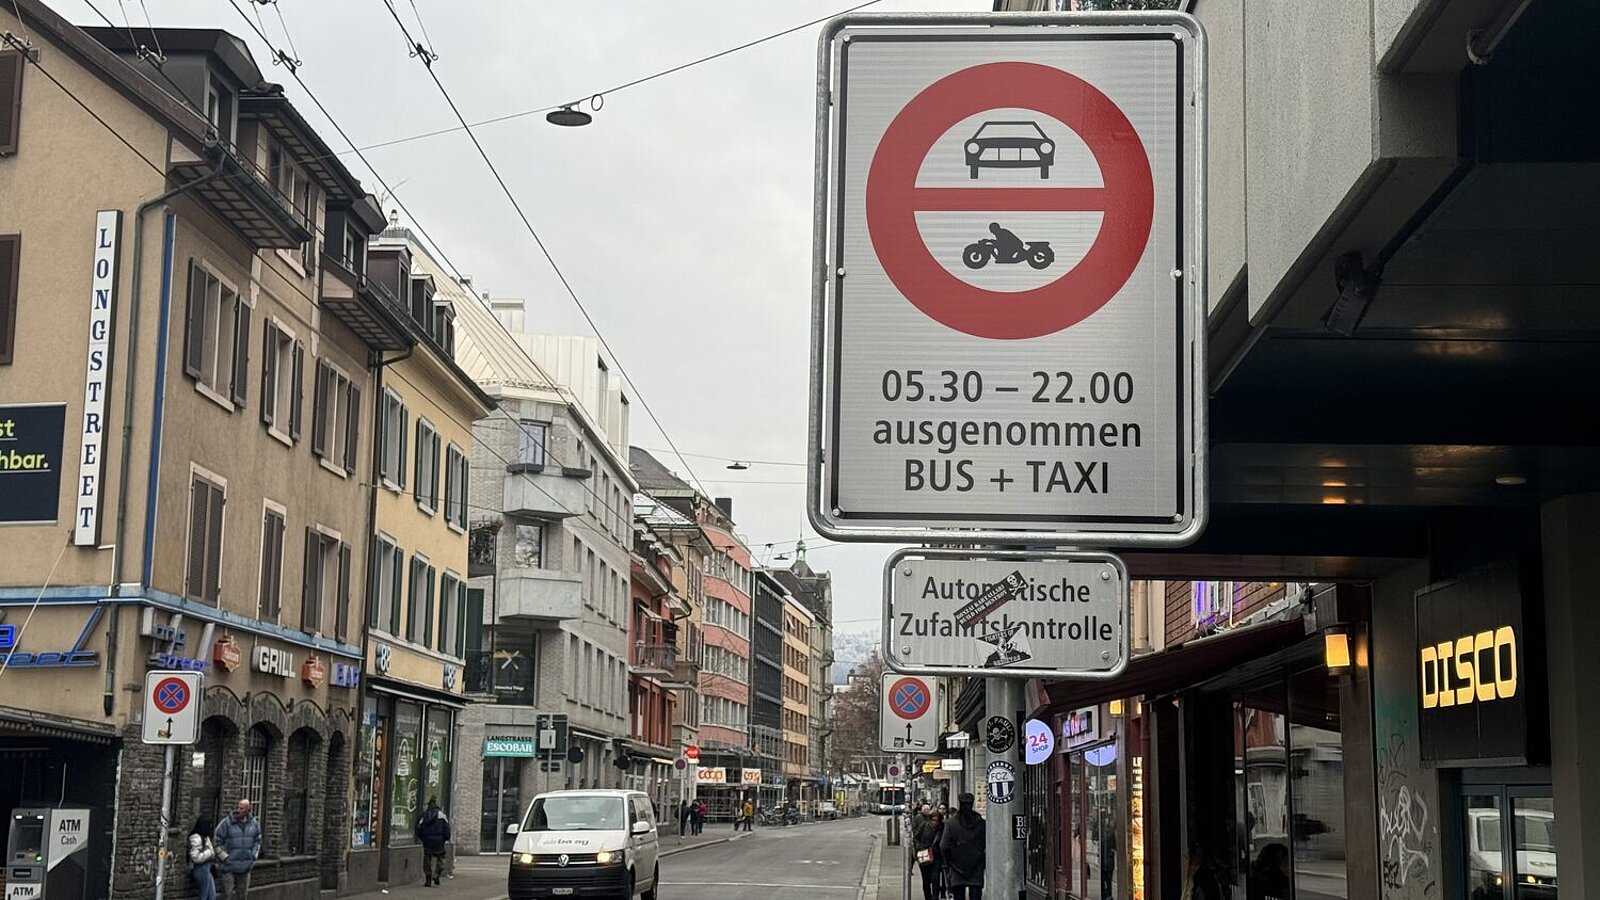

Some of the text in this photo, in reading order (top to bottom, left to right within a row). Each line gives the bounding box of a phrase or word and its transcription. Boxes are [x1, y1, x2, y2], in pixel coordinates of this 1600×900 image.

[81, 228, 112, 528] LONGSTREET
[882, 370, 983, 402] 05.30
[1032, 371, 1134, 404] 22.00
[873, 420, 1141, 454] ausgenommen
[905, 459, 975, 492] BUS
[1026, 461, 1108, 494] TAXI
[922, 576, 1090, 602] Autotische
[259, 646, 296, 678] GRILL
[335, 662, 360, 688] BAR
[1421, 626, 1517, 709] DISCO
[487, 743, 533, 752] ESCOBAR
[1029, 732, 1048, 747] 24
[1032, 744, 1049, 754] SHOP
[990, 771, 1008, 781] FCZ
[59, 819, 81, 831] ATM
[60, 835, 77, 845] Cash
[13, 887, 34, 896] ATM
